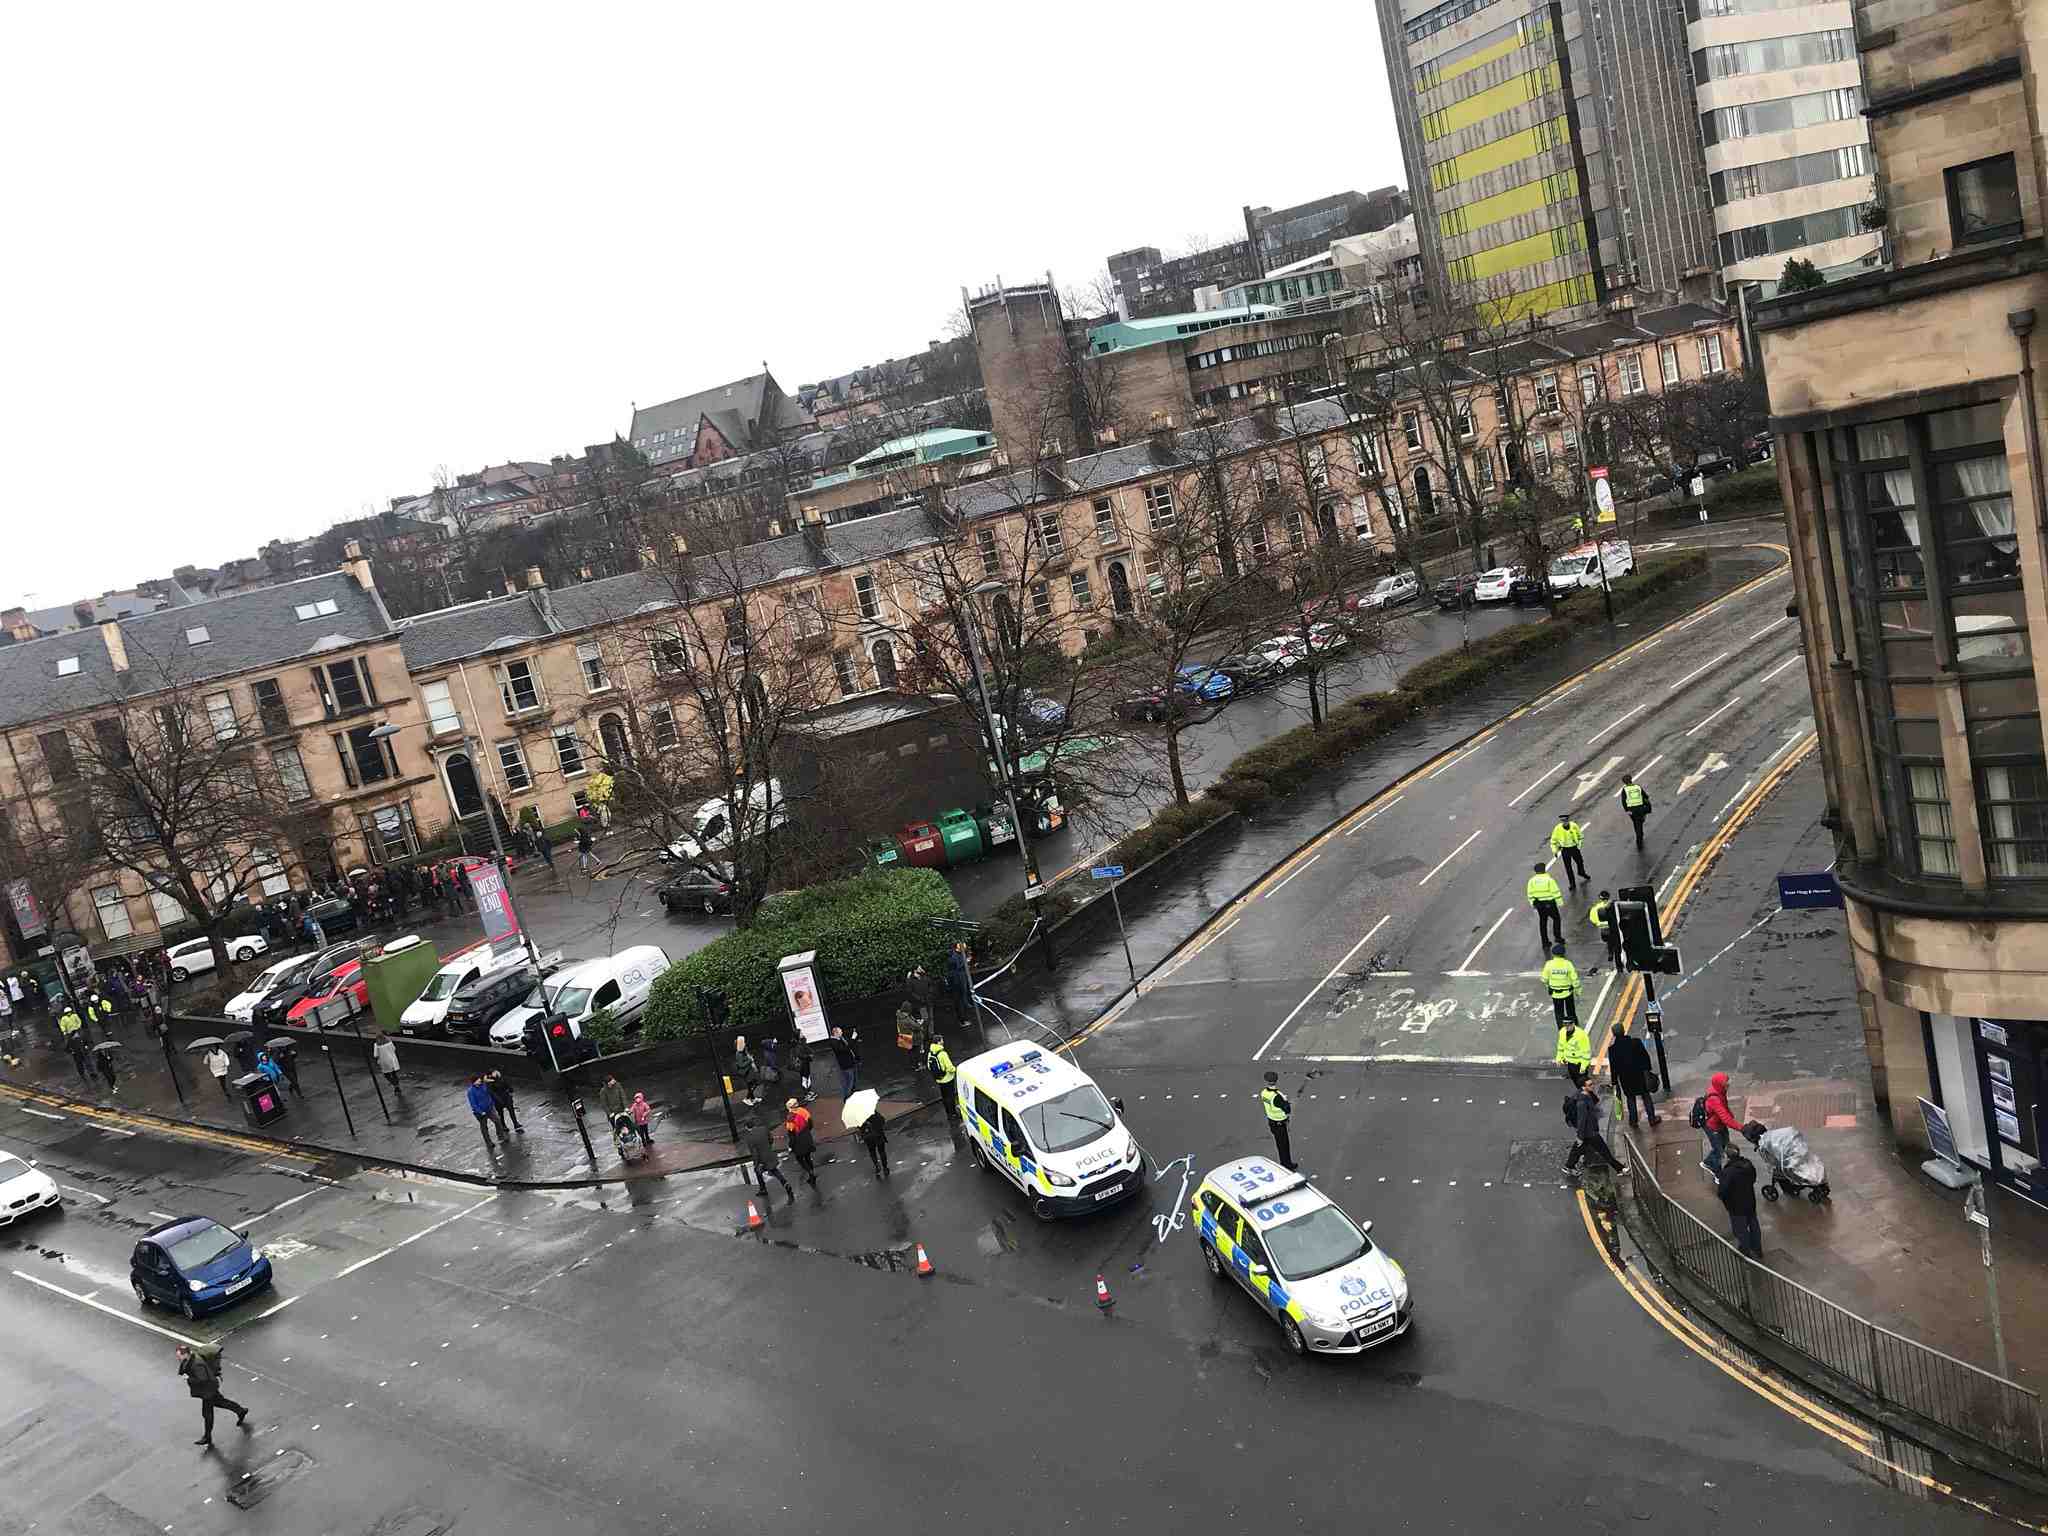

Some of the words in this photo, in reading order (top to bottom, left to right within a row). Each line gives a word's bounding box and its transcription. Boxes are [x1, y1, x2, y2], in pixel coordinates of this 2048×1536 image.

[475, 874, 501, 896] WEST
[481, 892, 502, 913] END
[1075, 1147, 1116, 1169] POLICE
[1256, 1201, 1290, 1221] 06
[1339, 1287, 1391, 1315] POLICE
